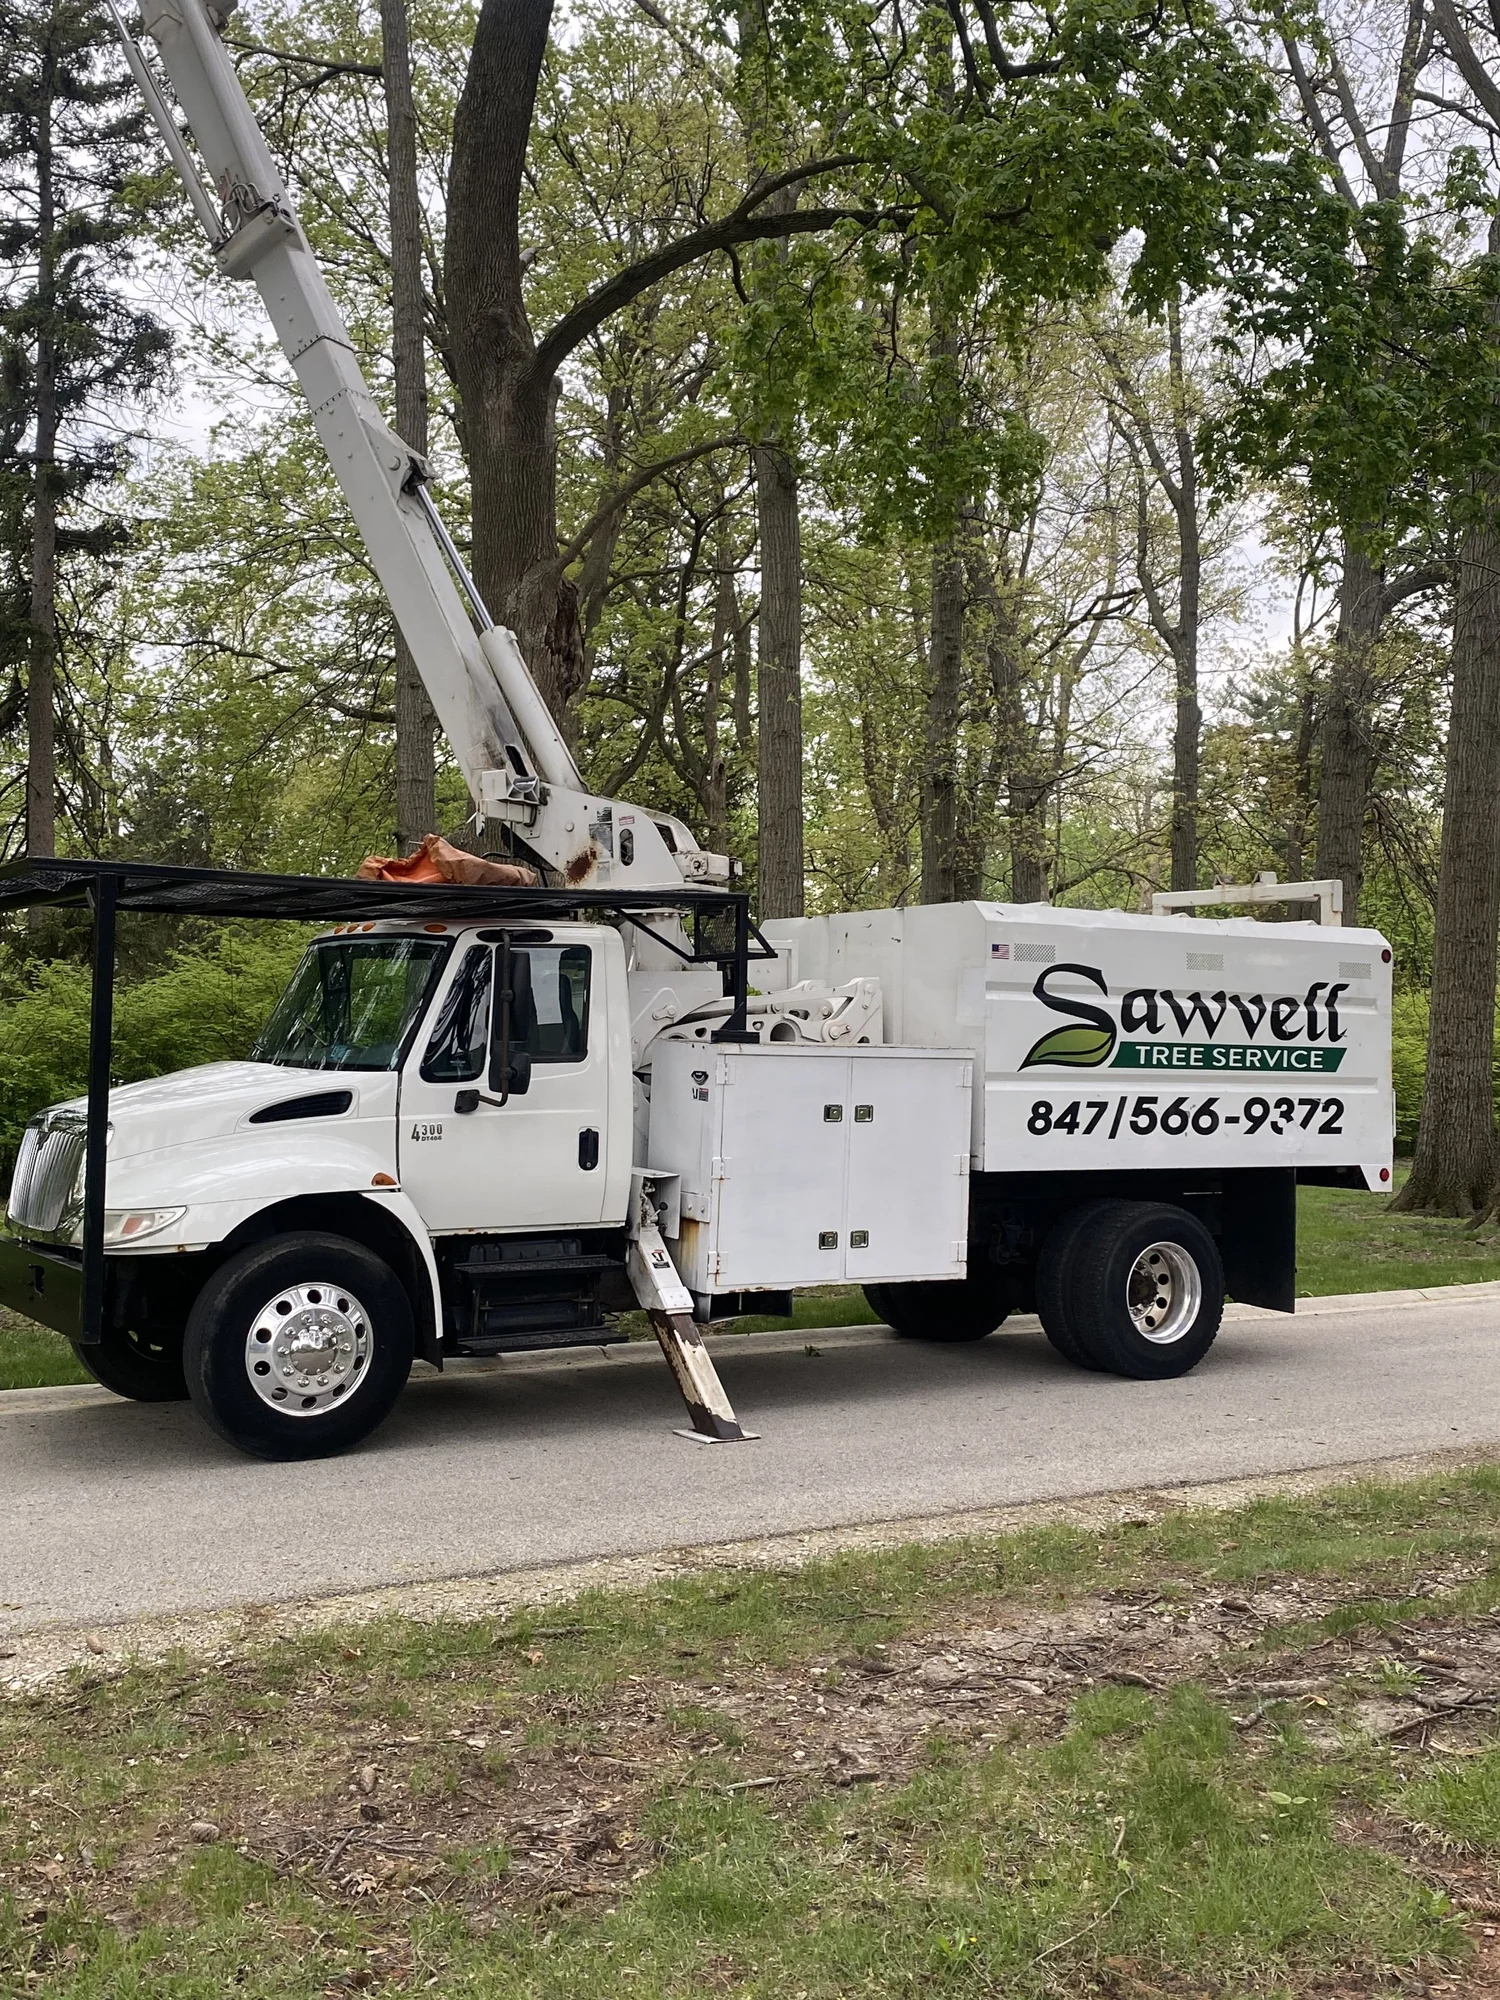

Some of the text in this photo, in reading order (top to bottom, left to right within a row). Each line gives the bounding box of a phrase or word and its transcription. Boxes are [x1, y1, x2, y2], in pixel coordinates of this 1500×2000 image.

[1017, 963, 1350, 1072] Sawvell
[1136, 1046, 1324, 1069] TREE SERVICE
[411, 1123, 443, 1142] 4300
[1027, 1096, 1345, 1139] 847/566-9372
